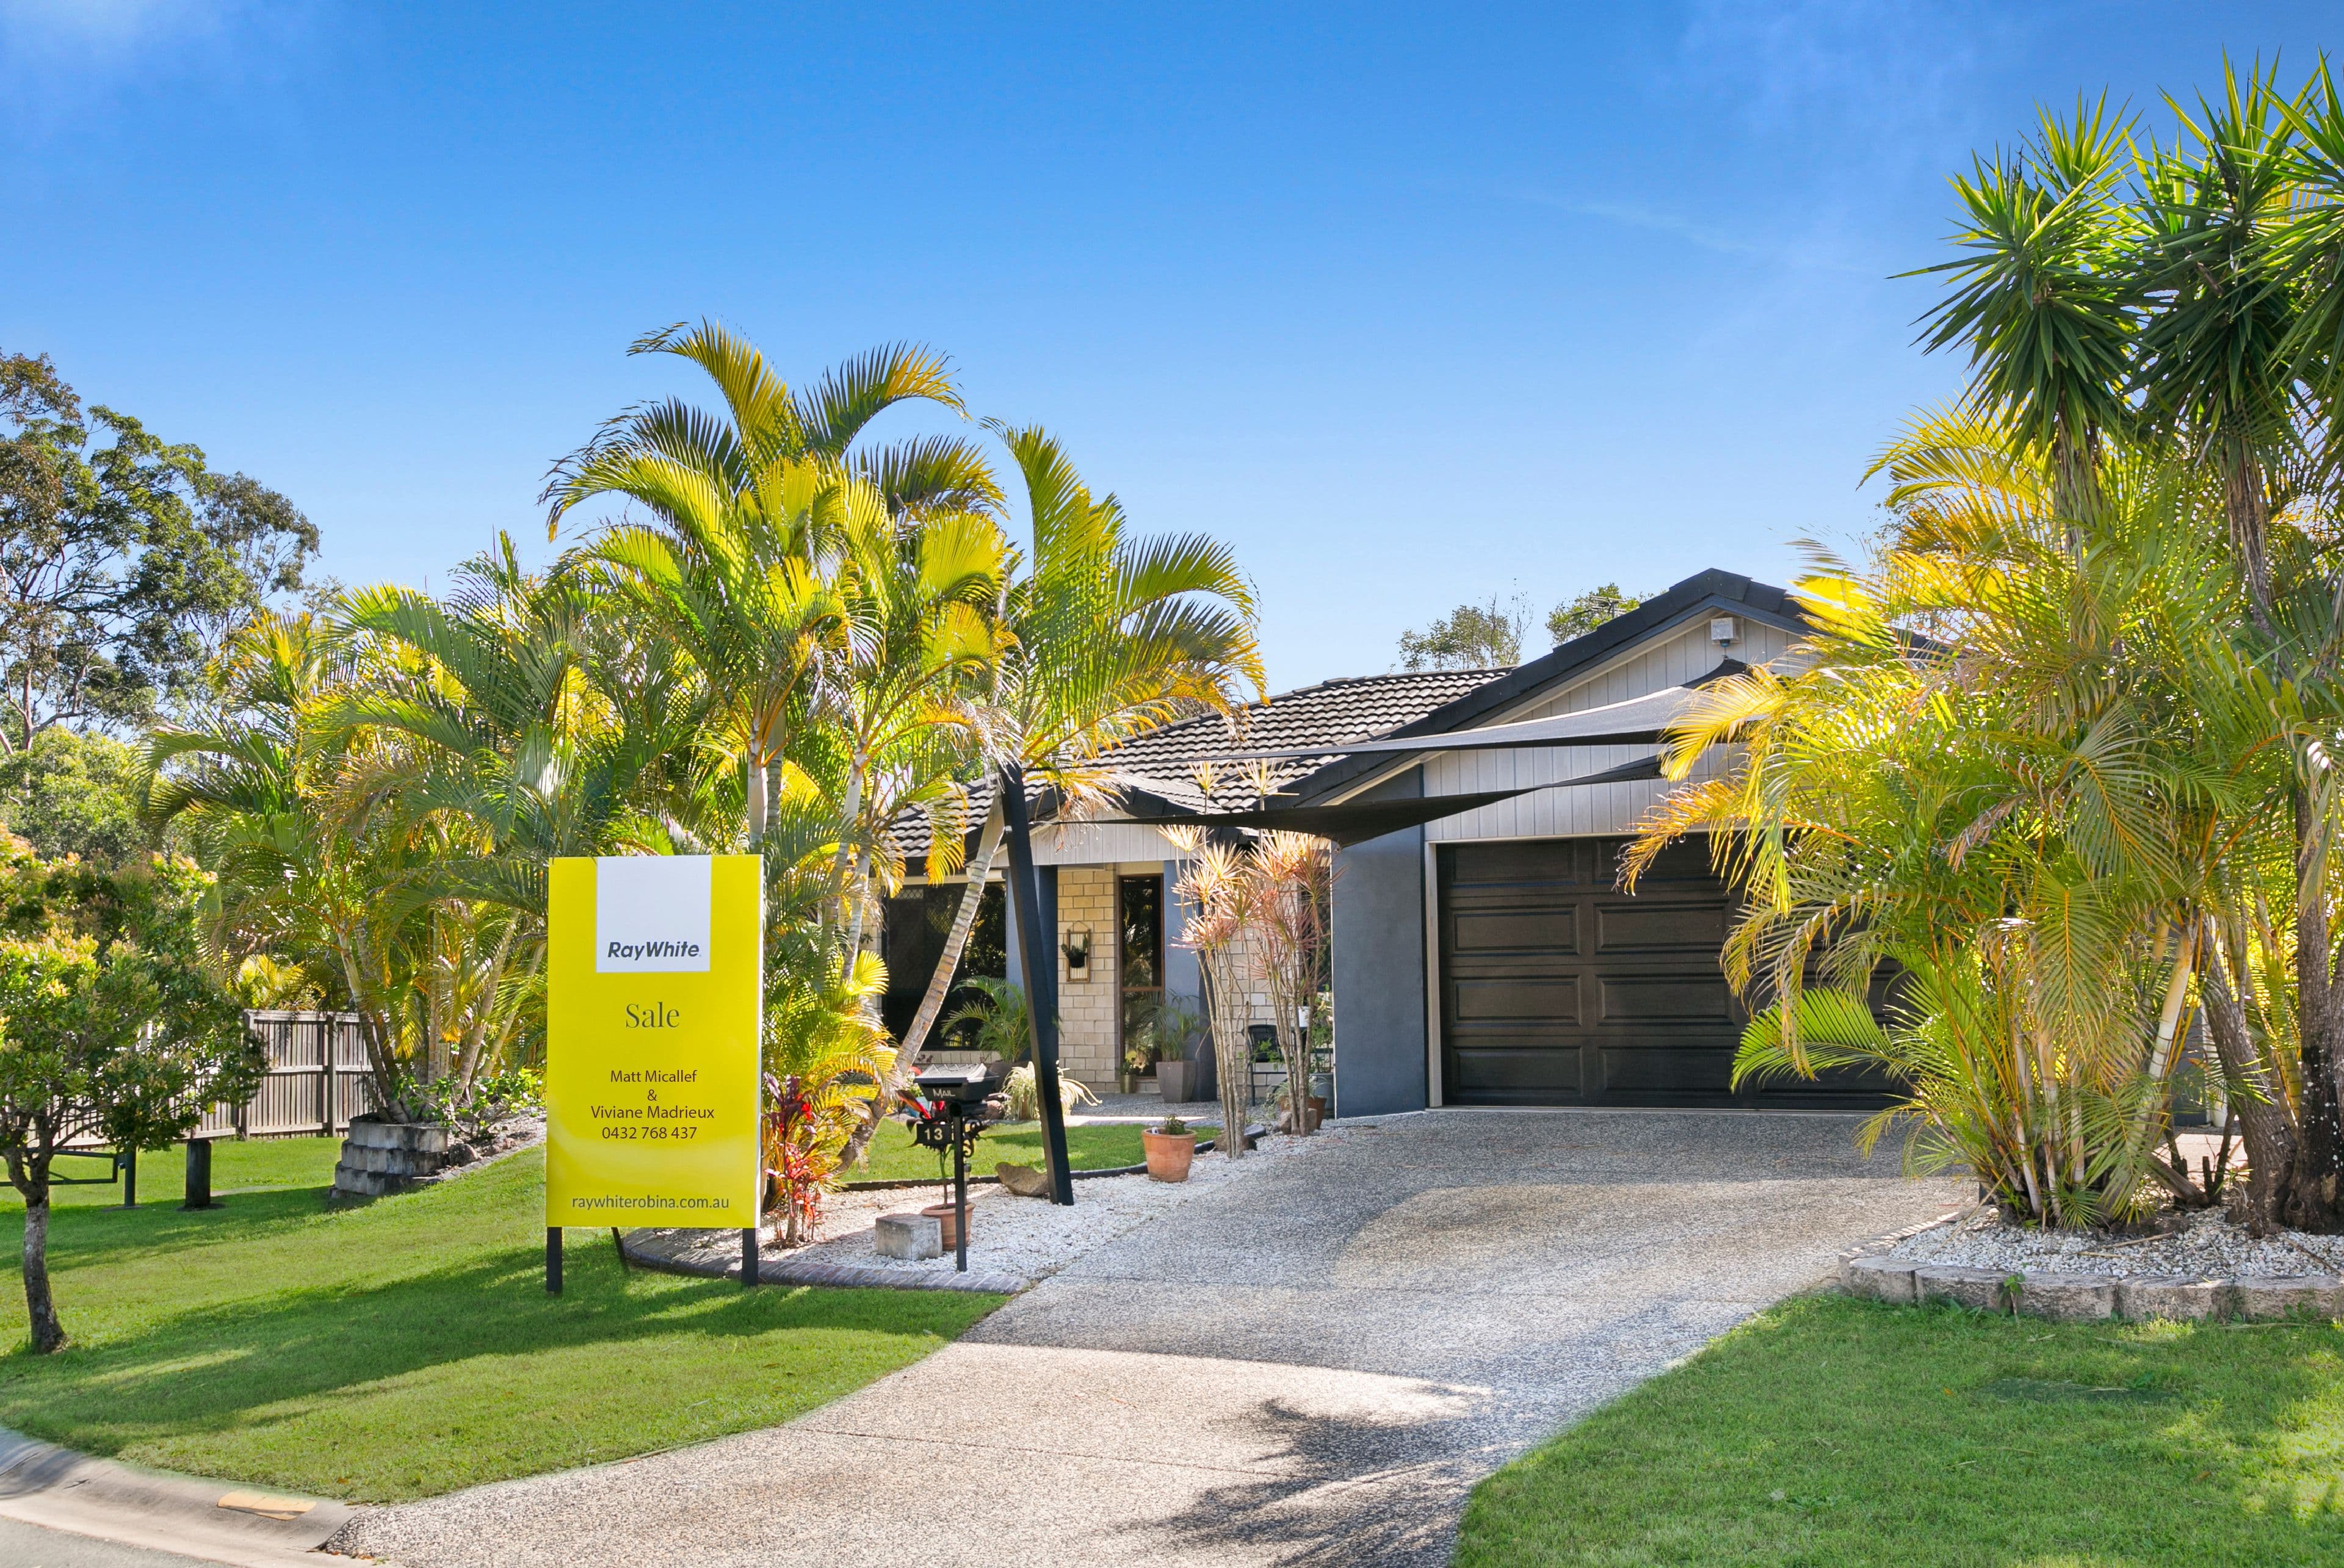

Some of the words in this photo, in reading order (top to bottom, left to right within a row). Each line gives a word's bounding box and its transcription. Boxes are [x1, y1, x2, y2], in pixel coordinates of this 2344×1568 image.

[625, 1002, 679, 1028] Sale
[610, 1070, 642, 1083] Matt
[645, 1069, 698, 1083] Micallef
[647, 1089, 657, 1101] &
[591, 1105, 643, 1118] Viviane
[647, 1105, 715, 1118] Madrieux
[602, 1127, 637, 1139] 0432
[641, 1127, 667, 1139] 768
[671, 1127, 697, 1139] 437
[924, 1127, 943, 1141] 13
[572, 1195, 729, 1210] raywhiterobina.com.au
